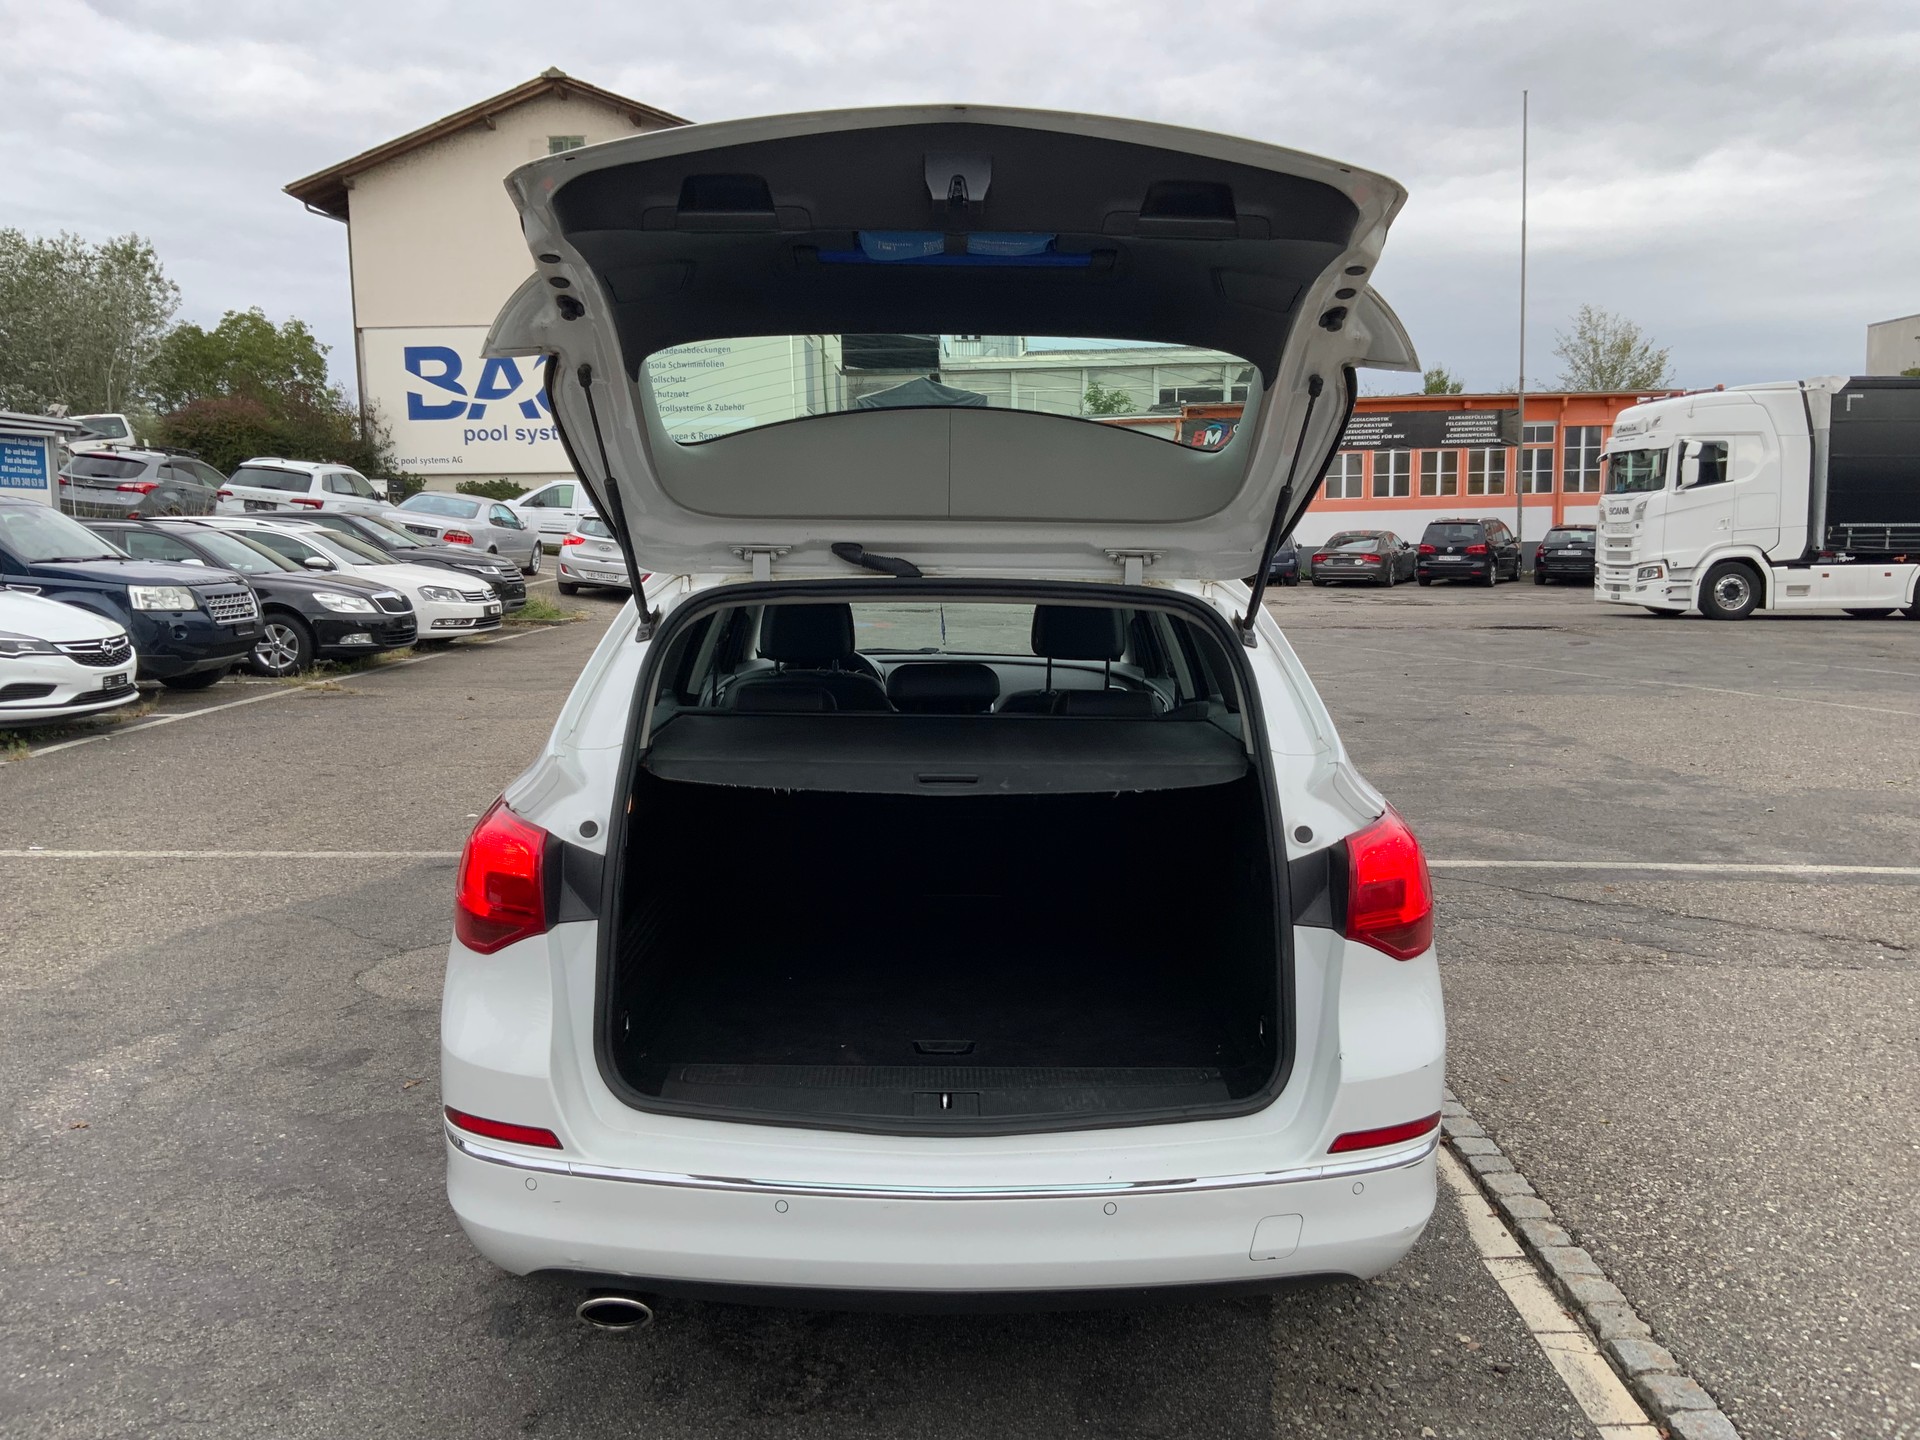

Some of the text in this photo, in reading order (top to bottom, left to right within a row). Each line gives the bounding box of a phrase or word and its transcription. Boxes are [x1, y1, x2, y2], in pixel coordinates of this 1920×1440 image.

[668, 360, 725, 369] Schwimmfolien
[659, 403, 745, 412] frollsysteme & Zubehör
[464, 425, 559, 446] pool syst
[401, 456, 417, 466] pool
[420, 457, 450, 466] systems
[452, 456, 463, 464] AG
[1609, 506, 1630, 515] SCANIA
